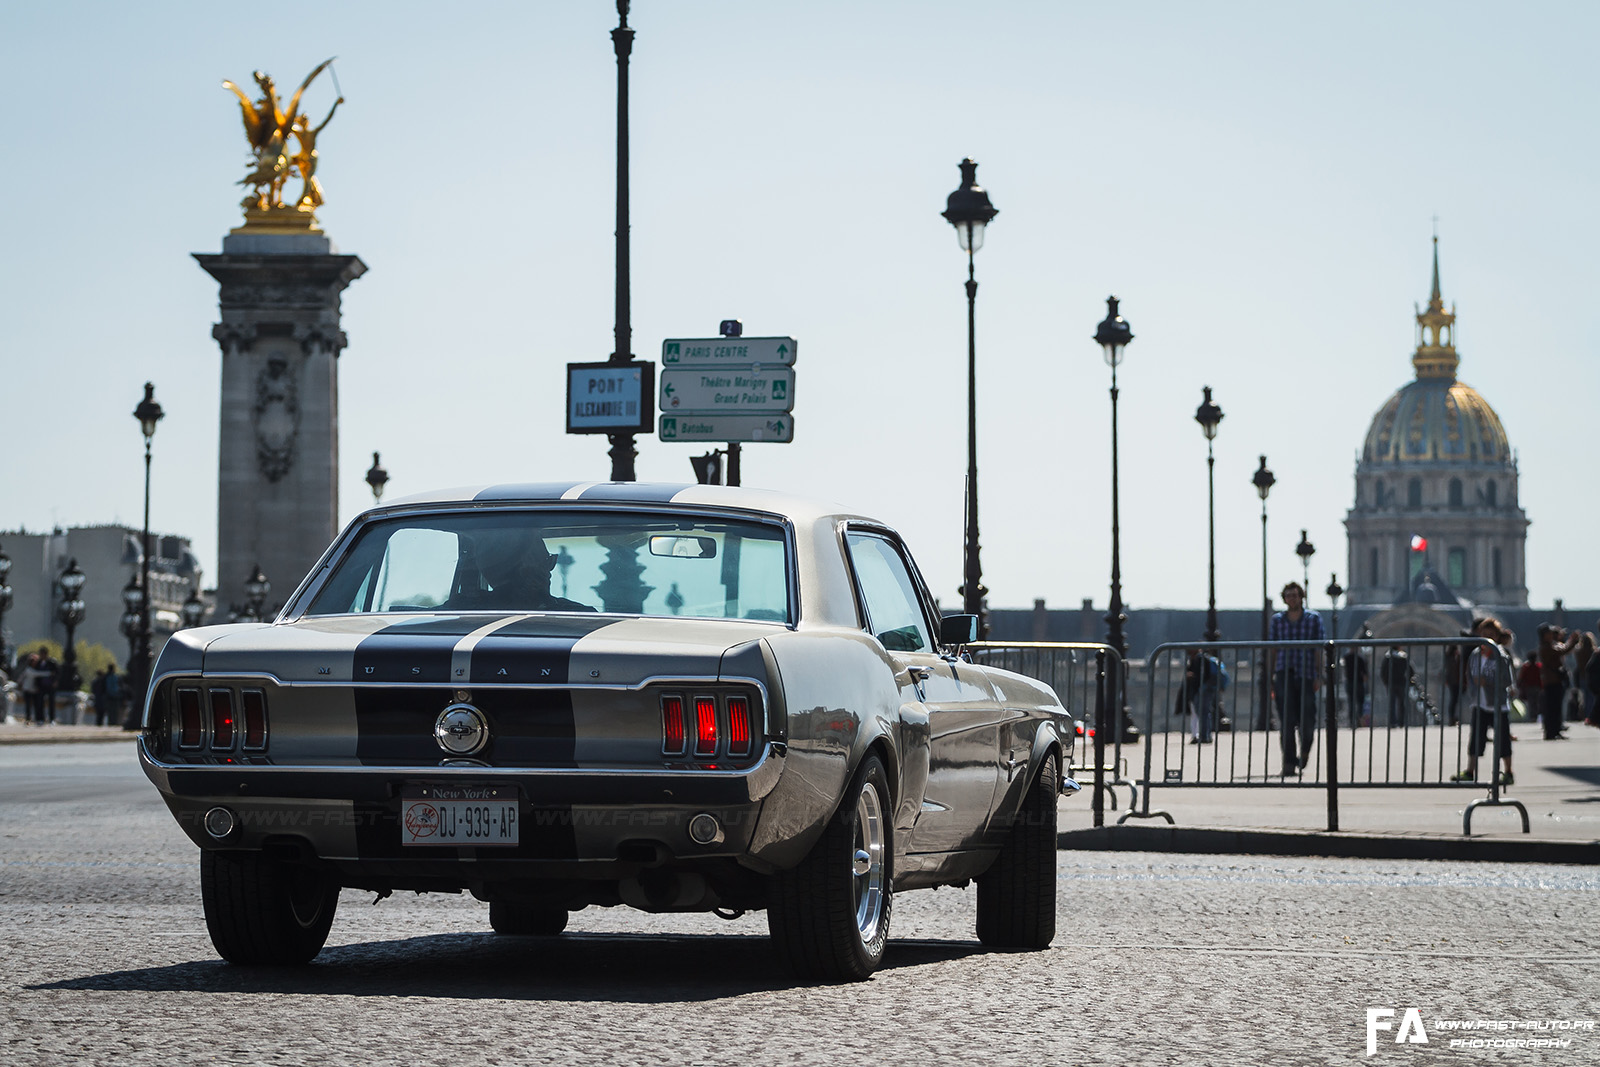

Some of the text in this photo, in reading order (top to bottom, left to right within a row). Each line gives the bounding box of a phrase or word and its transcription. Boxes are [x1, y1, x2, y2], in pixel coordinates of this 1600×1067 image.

[726, 321, 734, 334] 2
[684, 345, 749, 358] PARIS CENTRE
[588, 378, 624, 394] PONT
[735, 375, 768, 390] Marigny
[714, 392, 767, 404] Grand Palais
[681, 422, 714, 434] Batobus
[317, 665, 600, 678] MUSTANG
[432, 788, 490, 799] New York
